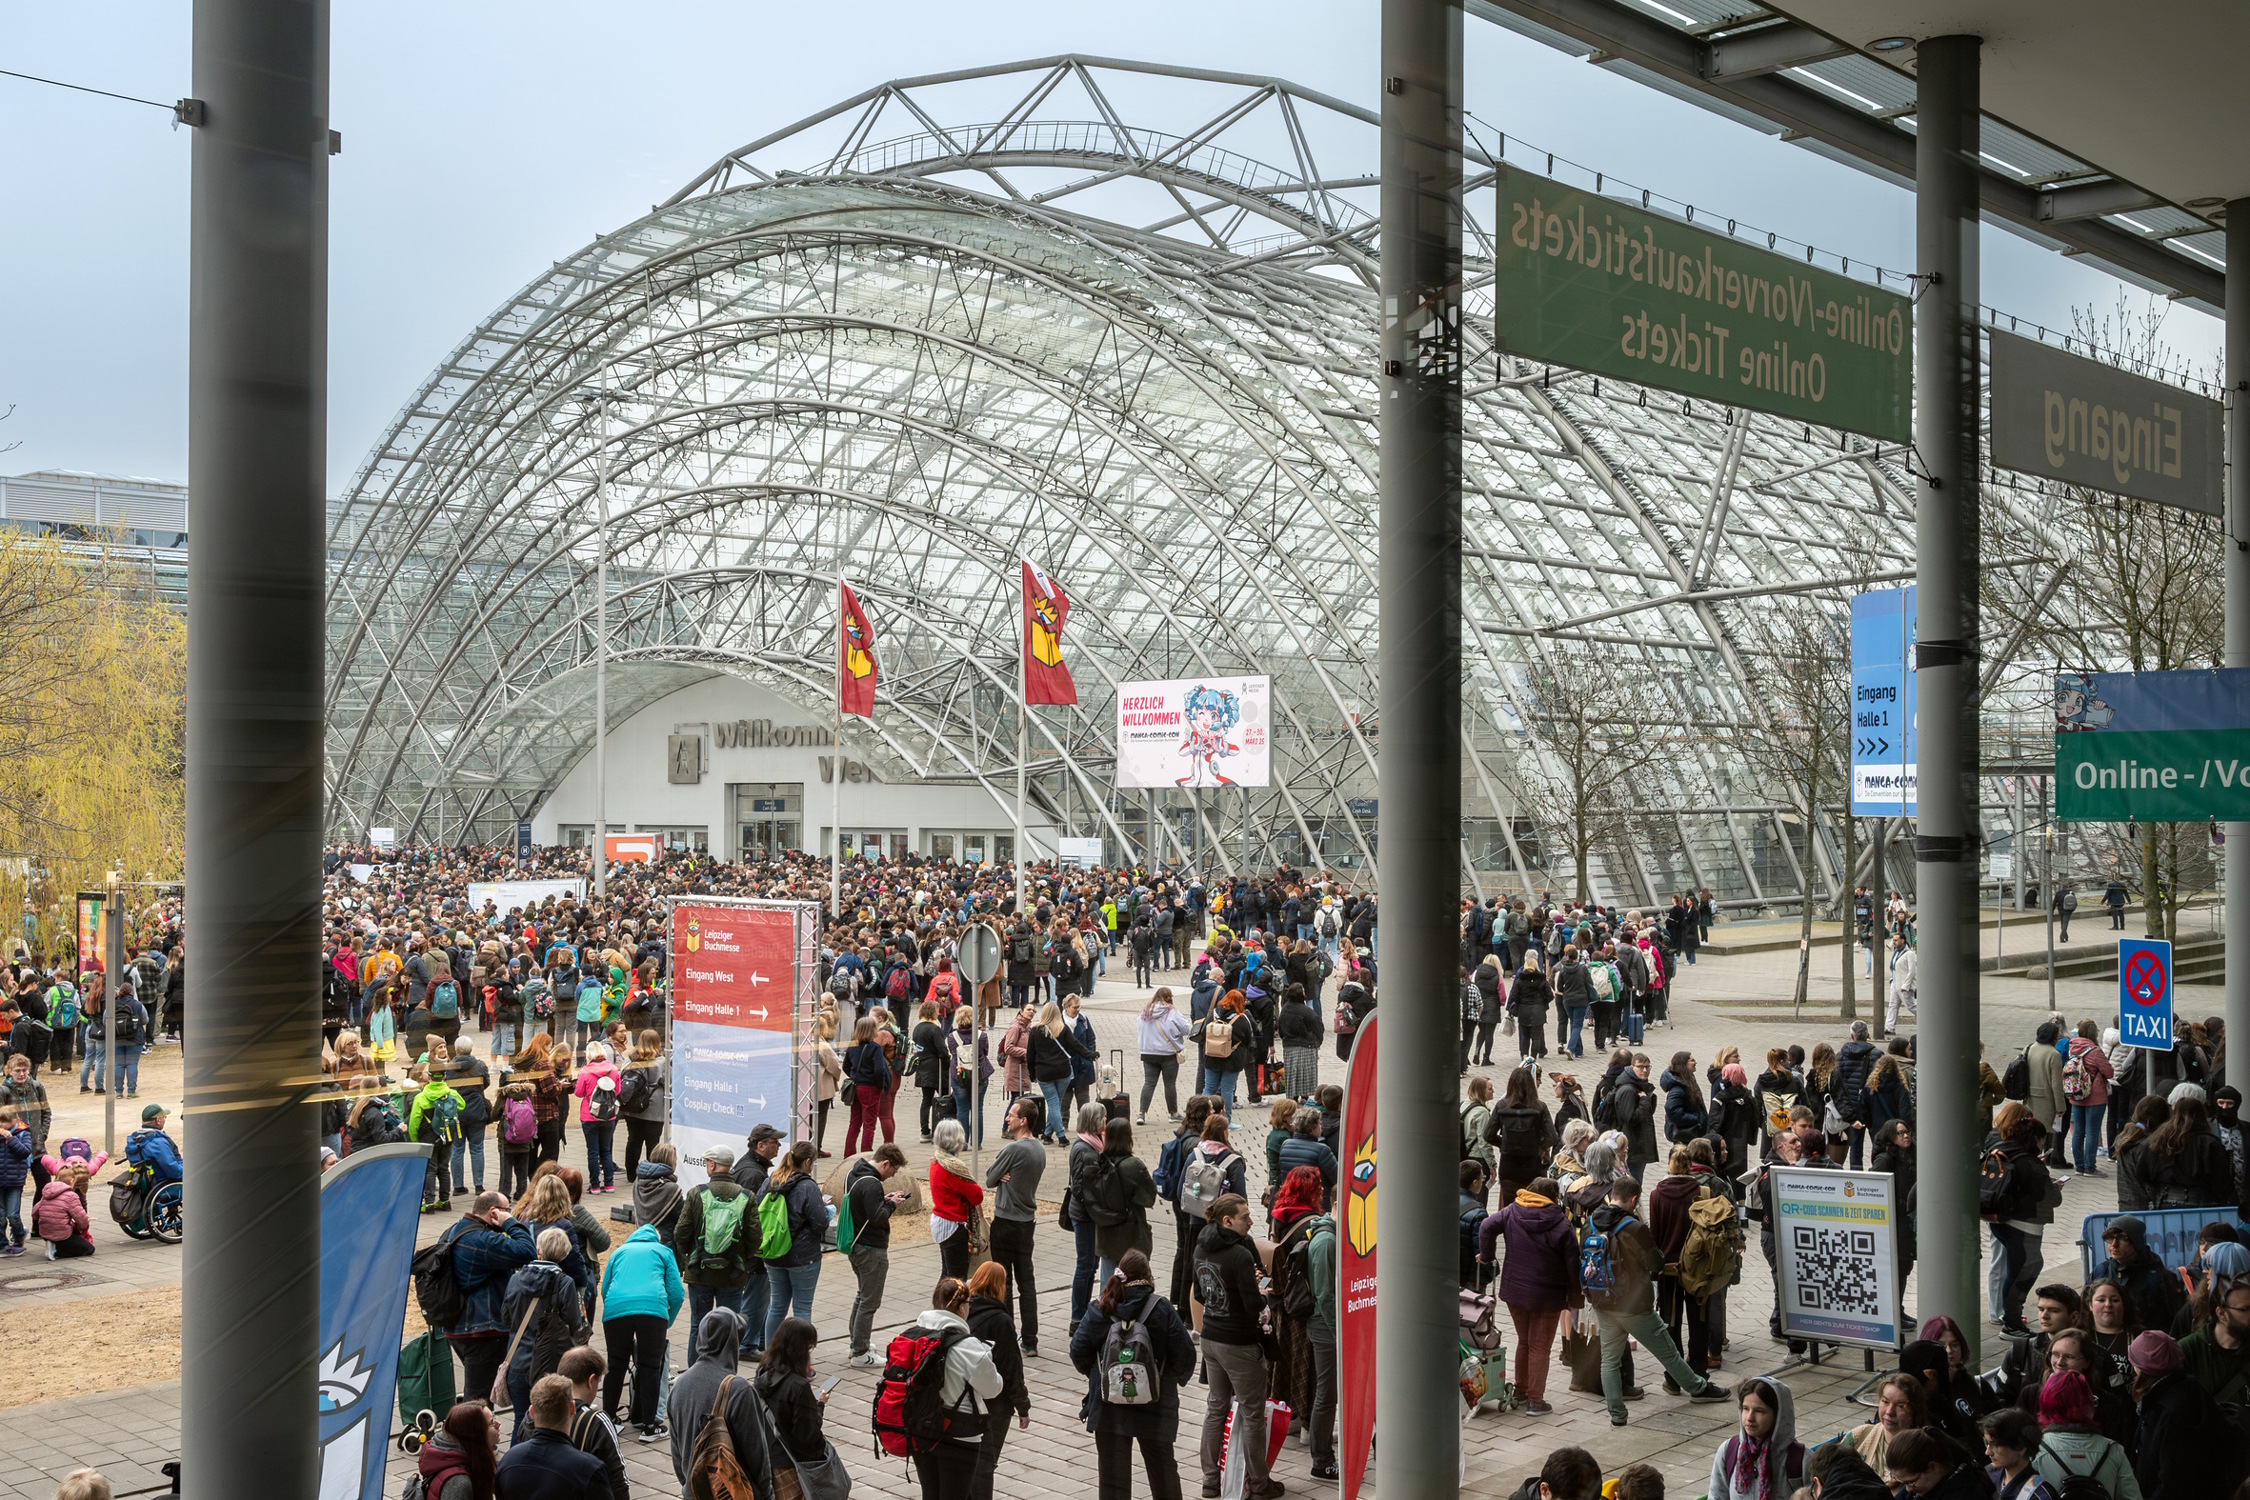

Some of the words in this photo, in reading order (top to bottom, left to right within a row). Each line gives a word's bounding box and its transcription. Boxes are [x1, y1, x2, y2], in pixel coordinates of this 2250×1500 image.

[1857, 684, 1897, 704] Eingang
[1122, 696, 1165, 711] HERZLICH
[1122, 711, 1181, 727] WILLKOMMEN
[1857, 711, 1880, 728] Halle
[1882, 710, 1889, 727] 1
[704, 929, 734, 942] Leipziger
[704, 940, 740, 953] Buchmesse
[686, 968, 714, 983] Eingang
[715, 970, 734, 983] West
[685, 1000, 714, 1016] Eingang
[715, 1003, 734, 1016] Halle
[736, 1005, 740, 1016] 1
[2124, 1013, 2167, 1040] TAXI
[684, 1076, 712, 1093] Eingang
[714, 1080, 733, 1093] Halle
[735, 1083, 739, 1094] 1
[684, 1097, 711, 1113] Cosplay
[713, 1102, 735, 1115] Check
[1781, 1202, 1817, 1216] QR-CODE
[1818, 1204, 1844, 1218] SCANNEN
[1845, 1207, 1850, 1218] &
[1850, 1207, 1862, 1219] ZEIT
[1863, 1208, 1886, 1221] SPAREN
